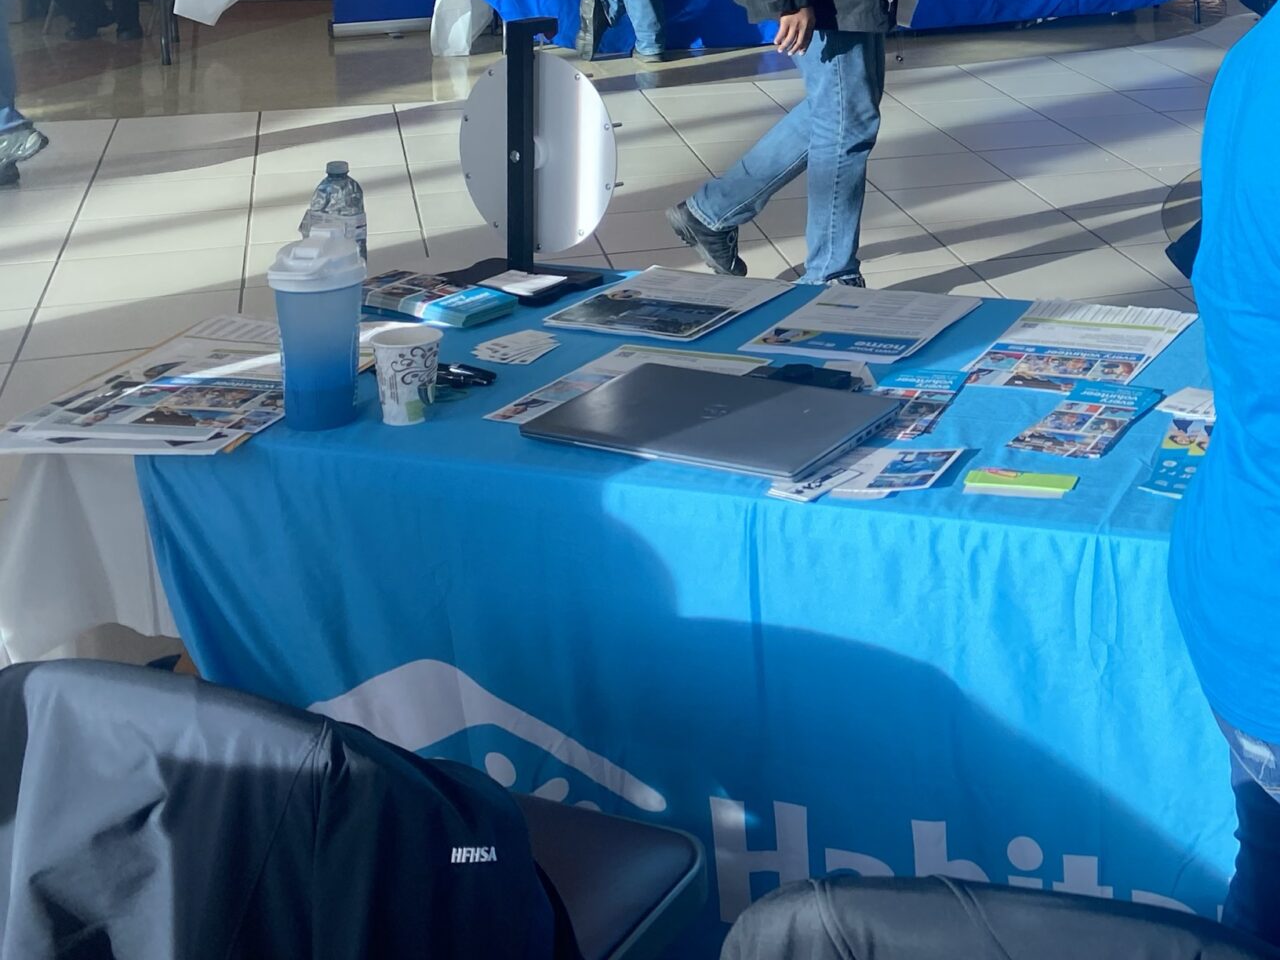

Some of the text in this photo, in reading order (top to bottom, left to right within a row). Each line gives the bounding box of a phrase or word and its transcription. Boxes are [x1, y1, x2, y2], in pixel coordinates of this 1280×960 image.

[854, 340, 906, 351] home
[1047, 348, 1101, 359] volunteer
[1103, 351, 1137, 361] every
[1080, 390, 1138, 402] volunteer
[1101, 397, 1136, 406] every
[450, 846, 498, 863] HFHSA
